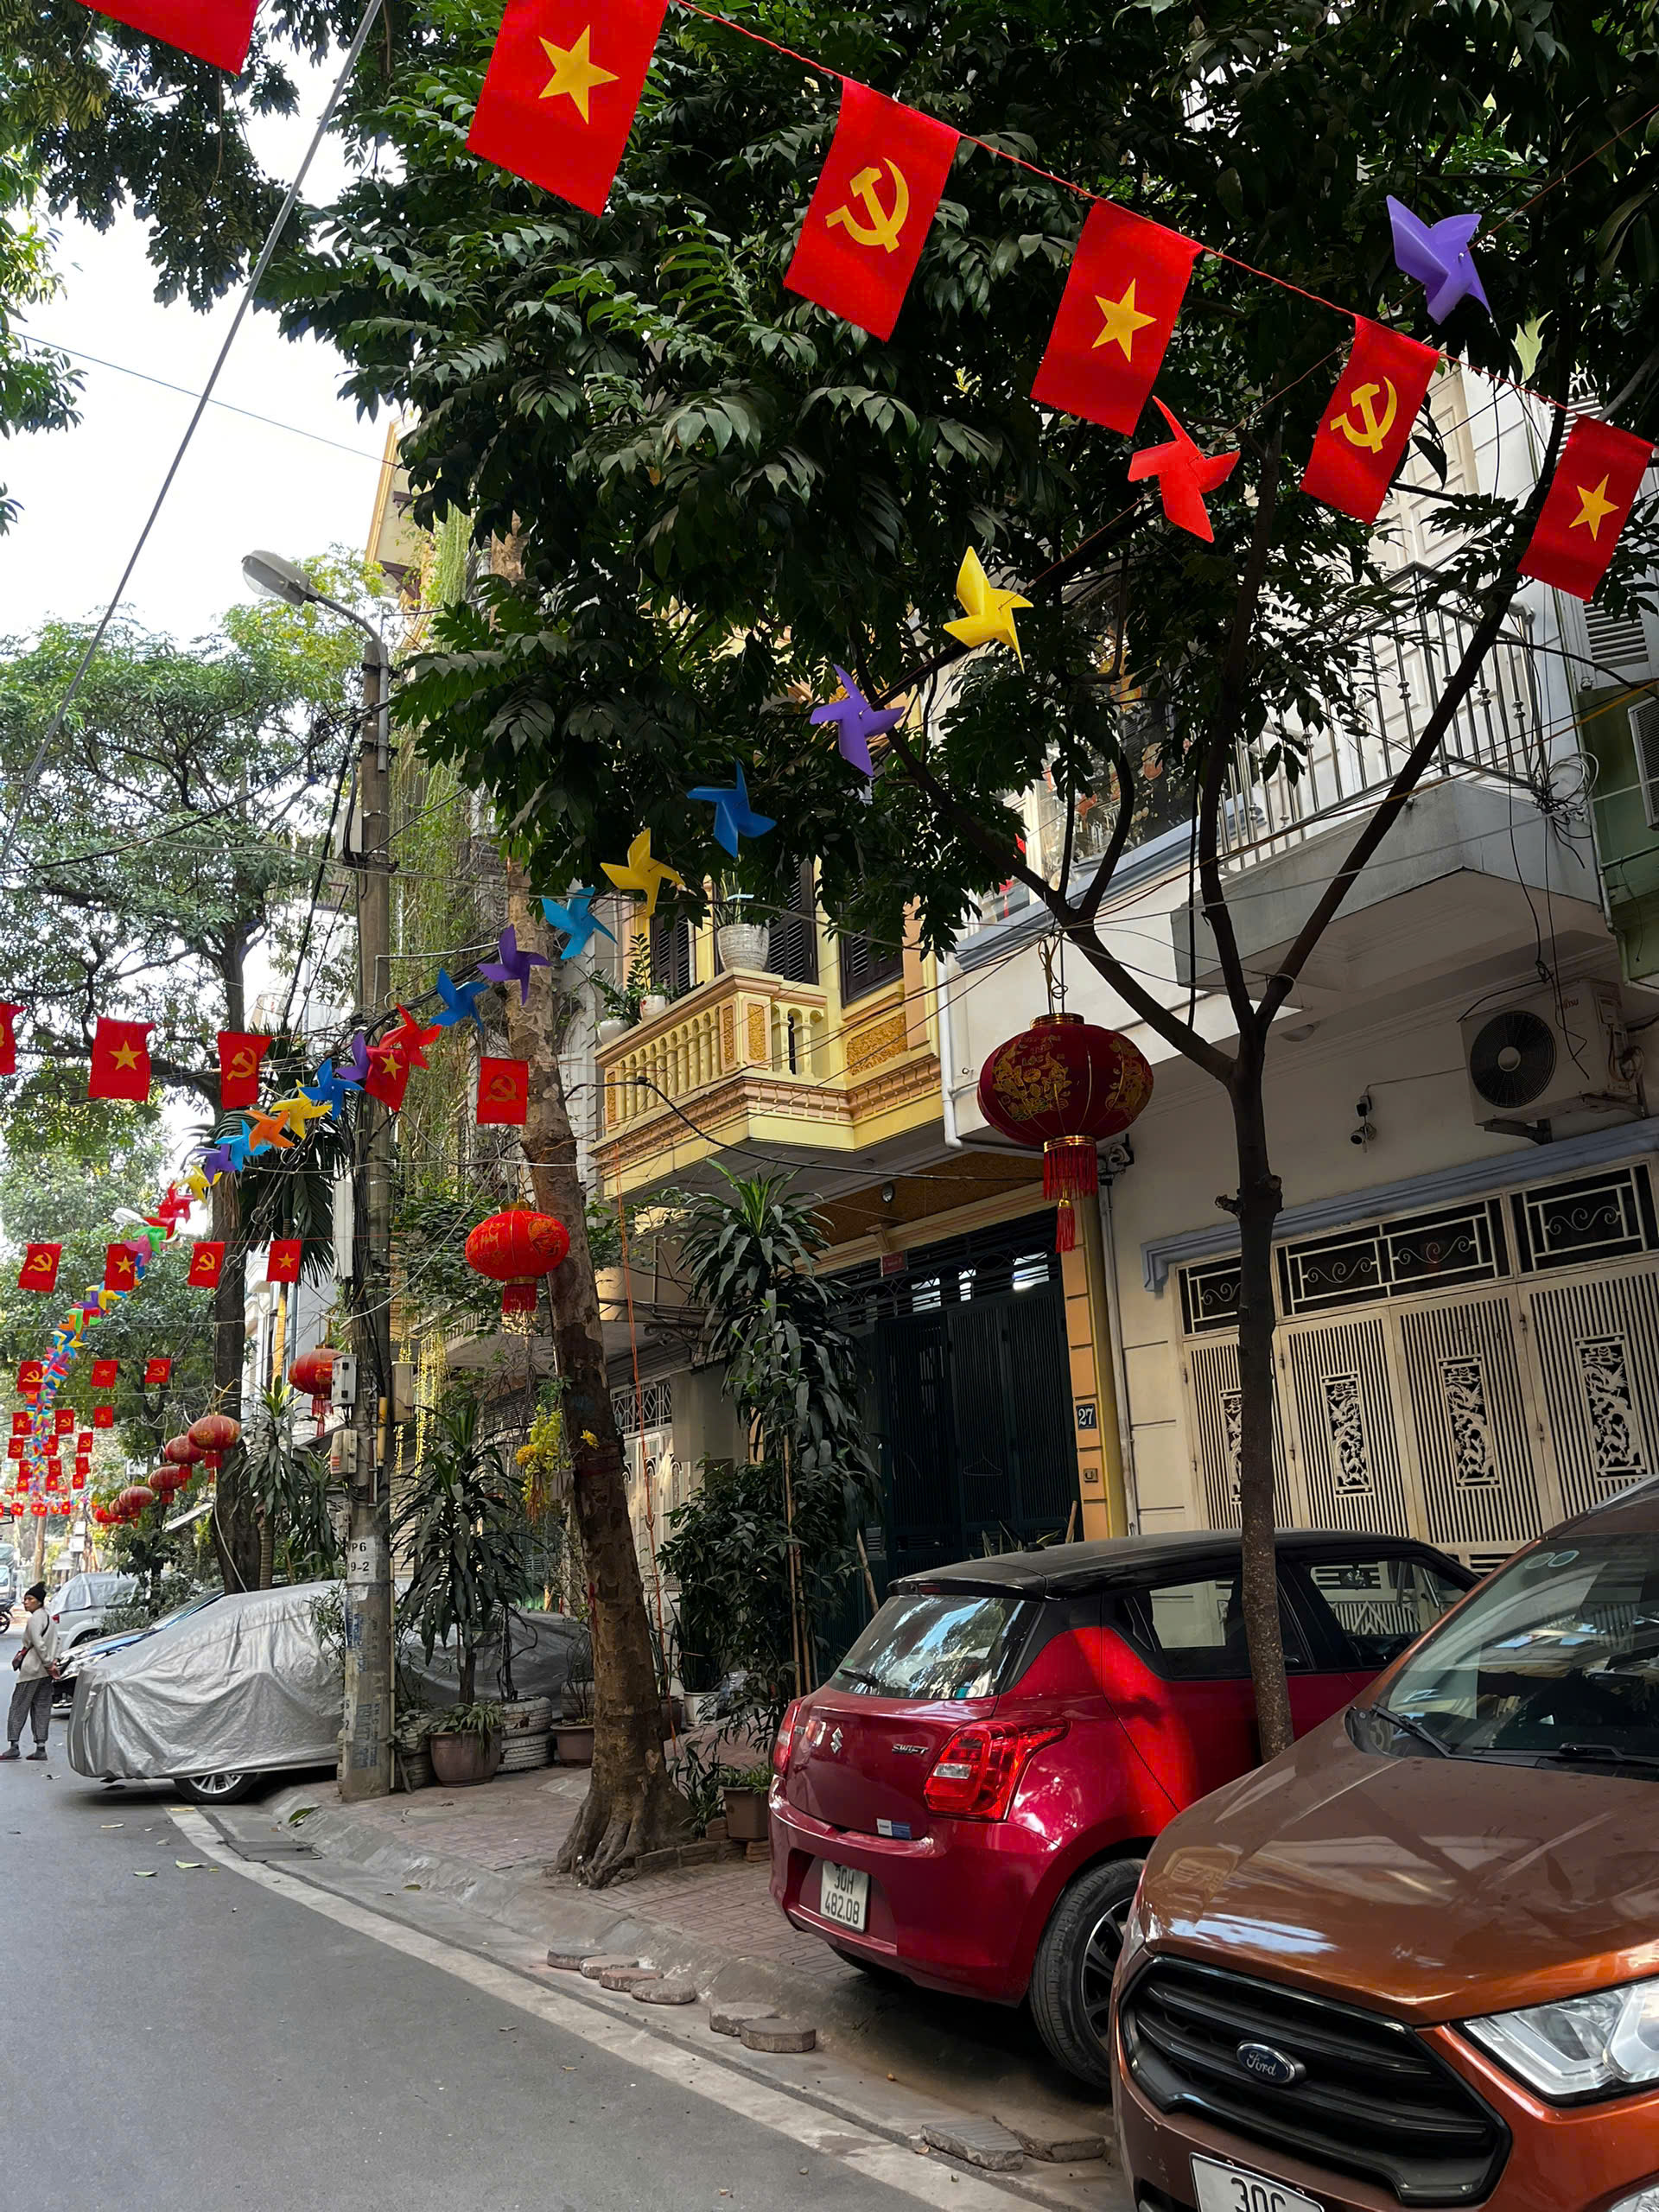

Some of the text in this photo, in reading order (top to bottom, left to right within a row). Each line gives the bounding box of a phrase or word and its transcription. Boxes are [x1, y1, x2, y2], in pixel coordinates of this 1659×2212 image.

[1078, 1407, 1094, 1426] 27
[892, 1744, 929, 1754] SWIFT
[834, 1866, 855, 1895] 30H
[825, 1891, 860, 1924] 482.08
[1246, 2050, 1277, 2076] Ford
